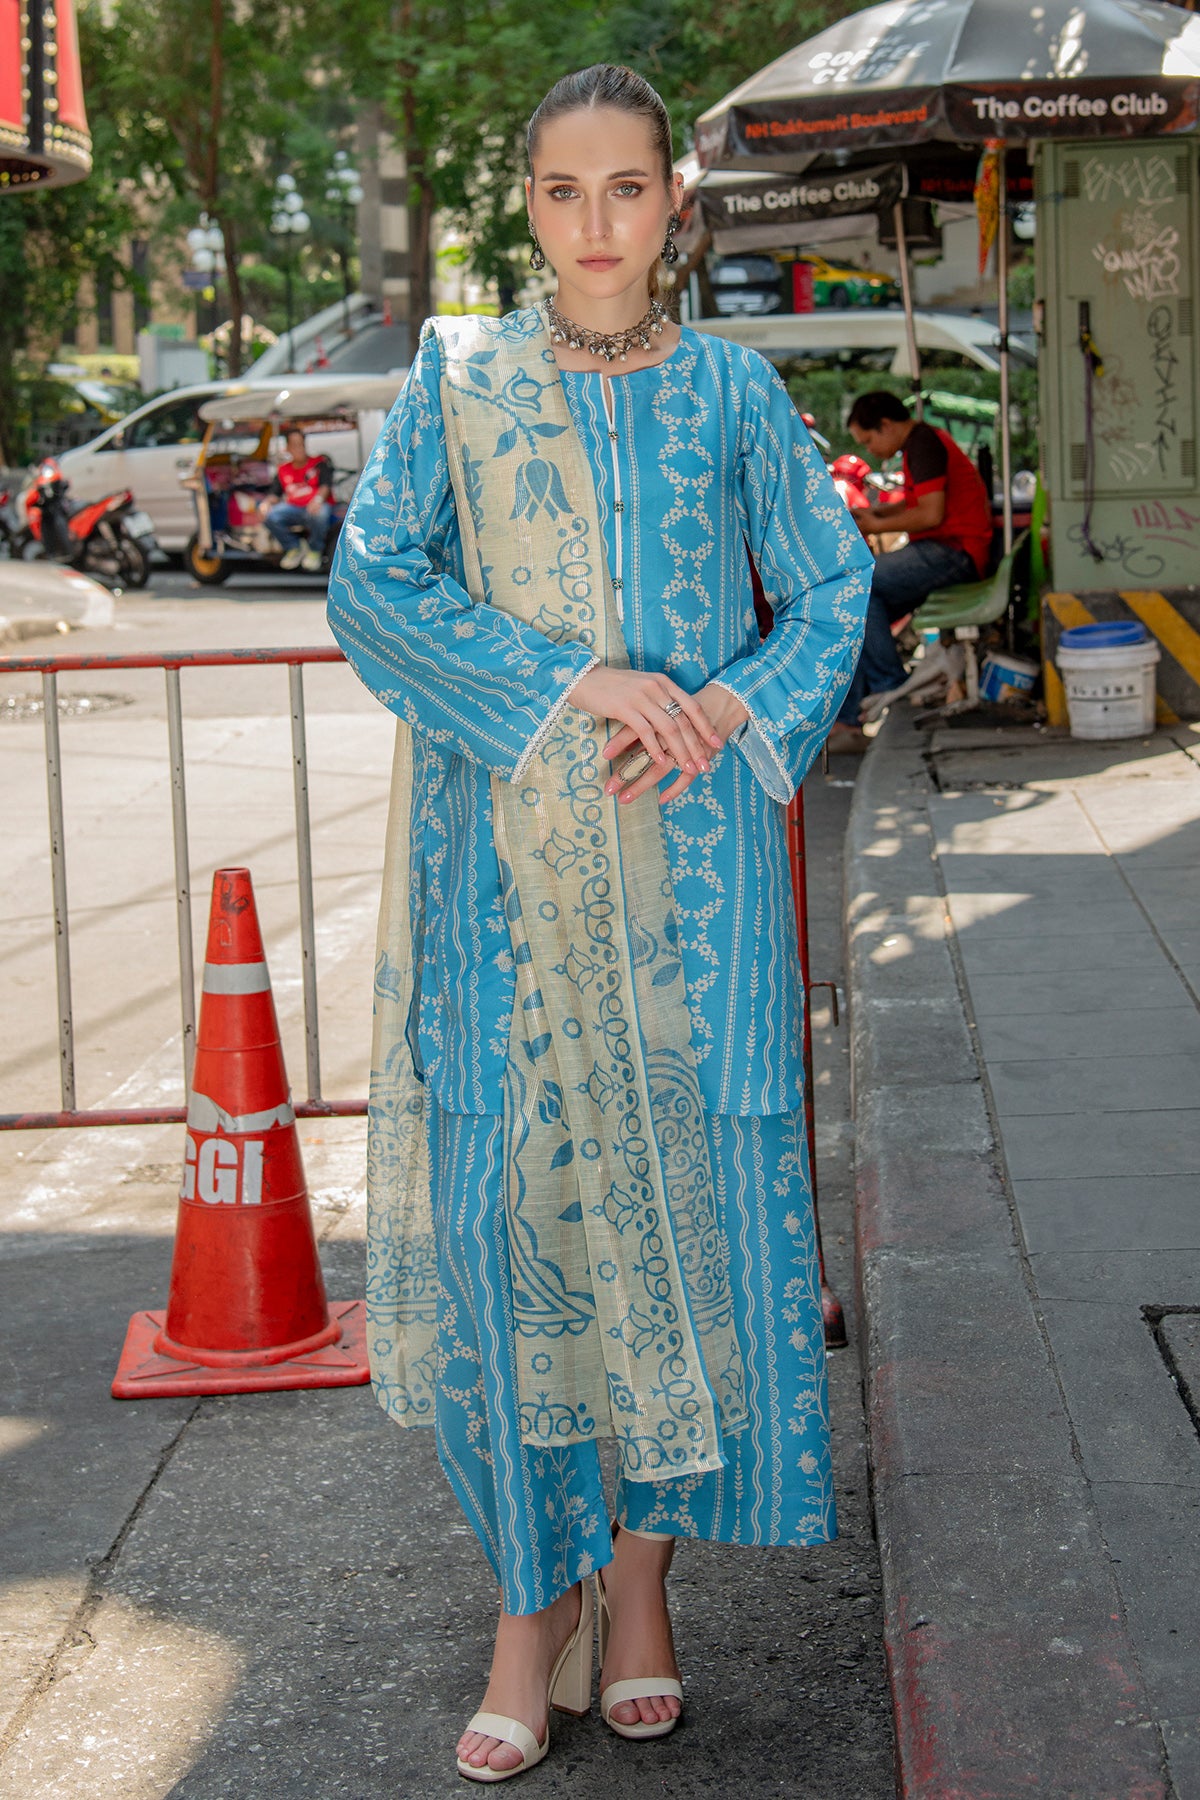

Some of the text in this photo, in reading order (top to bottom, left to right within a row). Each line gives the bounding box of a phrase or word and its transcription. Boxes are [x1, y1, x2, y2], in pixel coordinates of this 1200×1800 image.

[770, 114, 848, 136] Sukhumvit
[850, 105, 928, 129] Boulevard
[972, 92, 1168, 119] The Coffee Club
[723, 178, 880, 214] The Coffee Club
